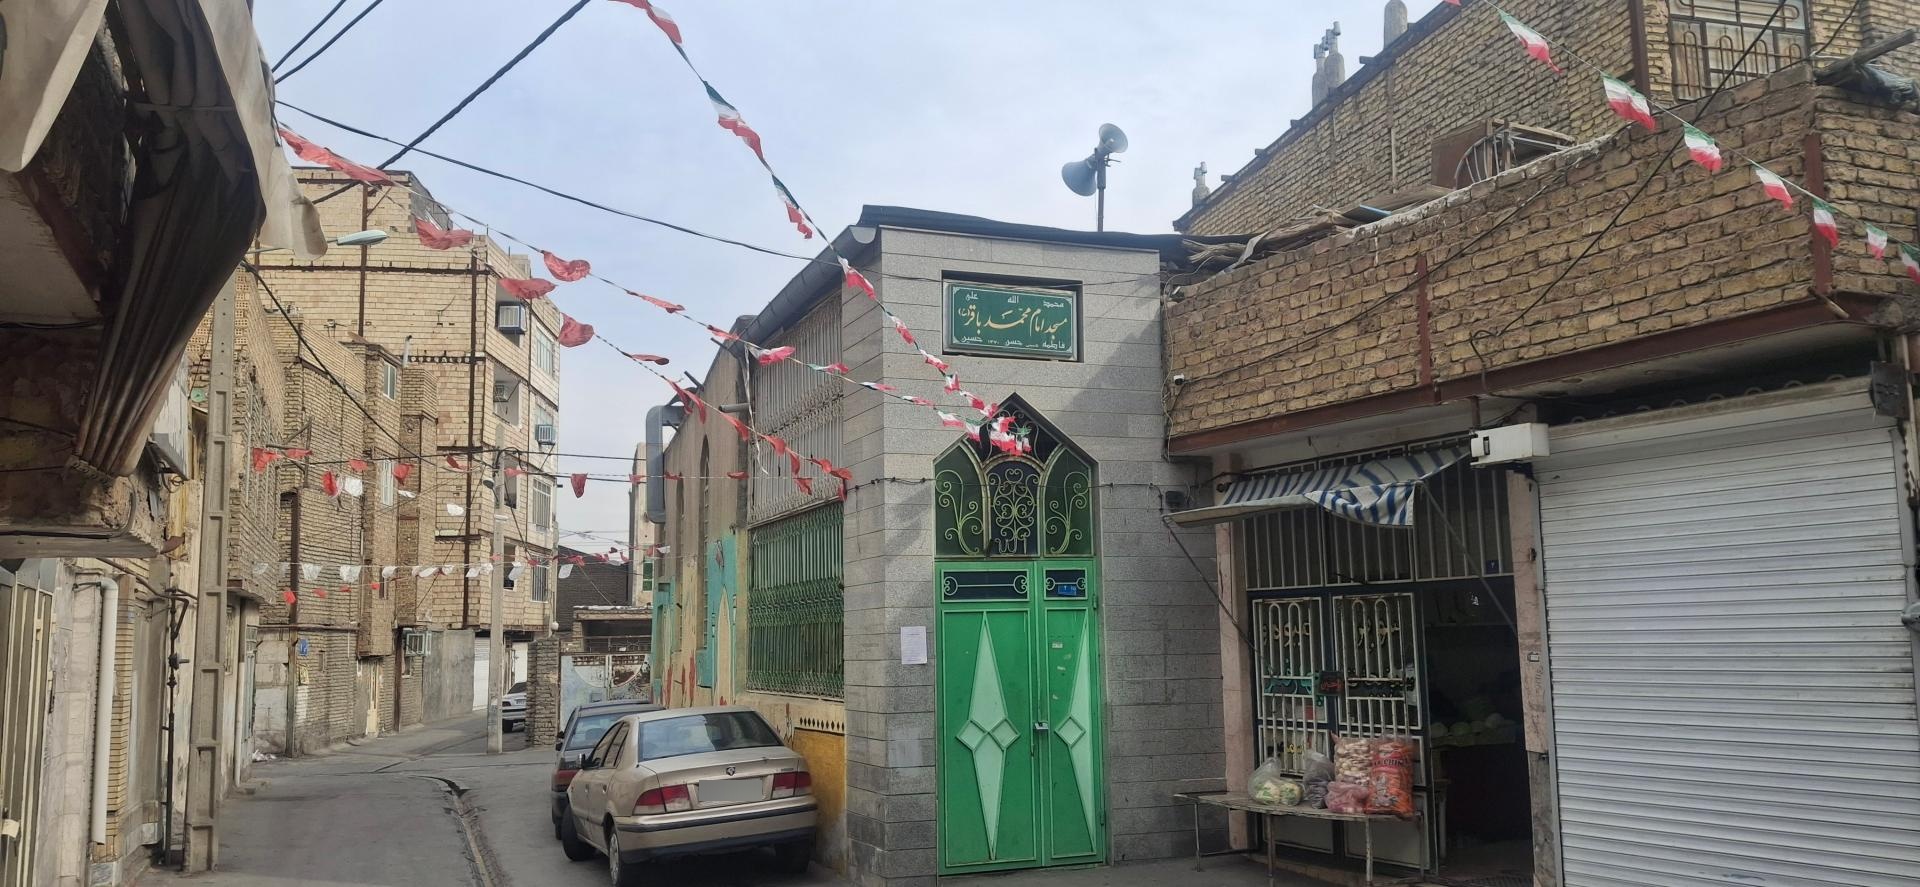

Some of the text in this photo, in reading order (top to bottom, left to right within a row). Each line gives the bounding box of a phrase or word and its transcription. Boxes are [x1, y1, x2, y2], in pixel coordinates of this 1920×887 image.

[965, 291, 979, 301] علی
[1007, 296, 1019, 304] الله
[1030, 308, 1045, 337] امام
[1044, 316, 1068, 340] مسجد
[961, 336, 983, 344] حسین
[1004, 339, 1023, 347] حسن
[1042, 339, 1066, 349] فاطمه
